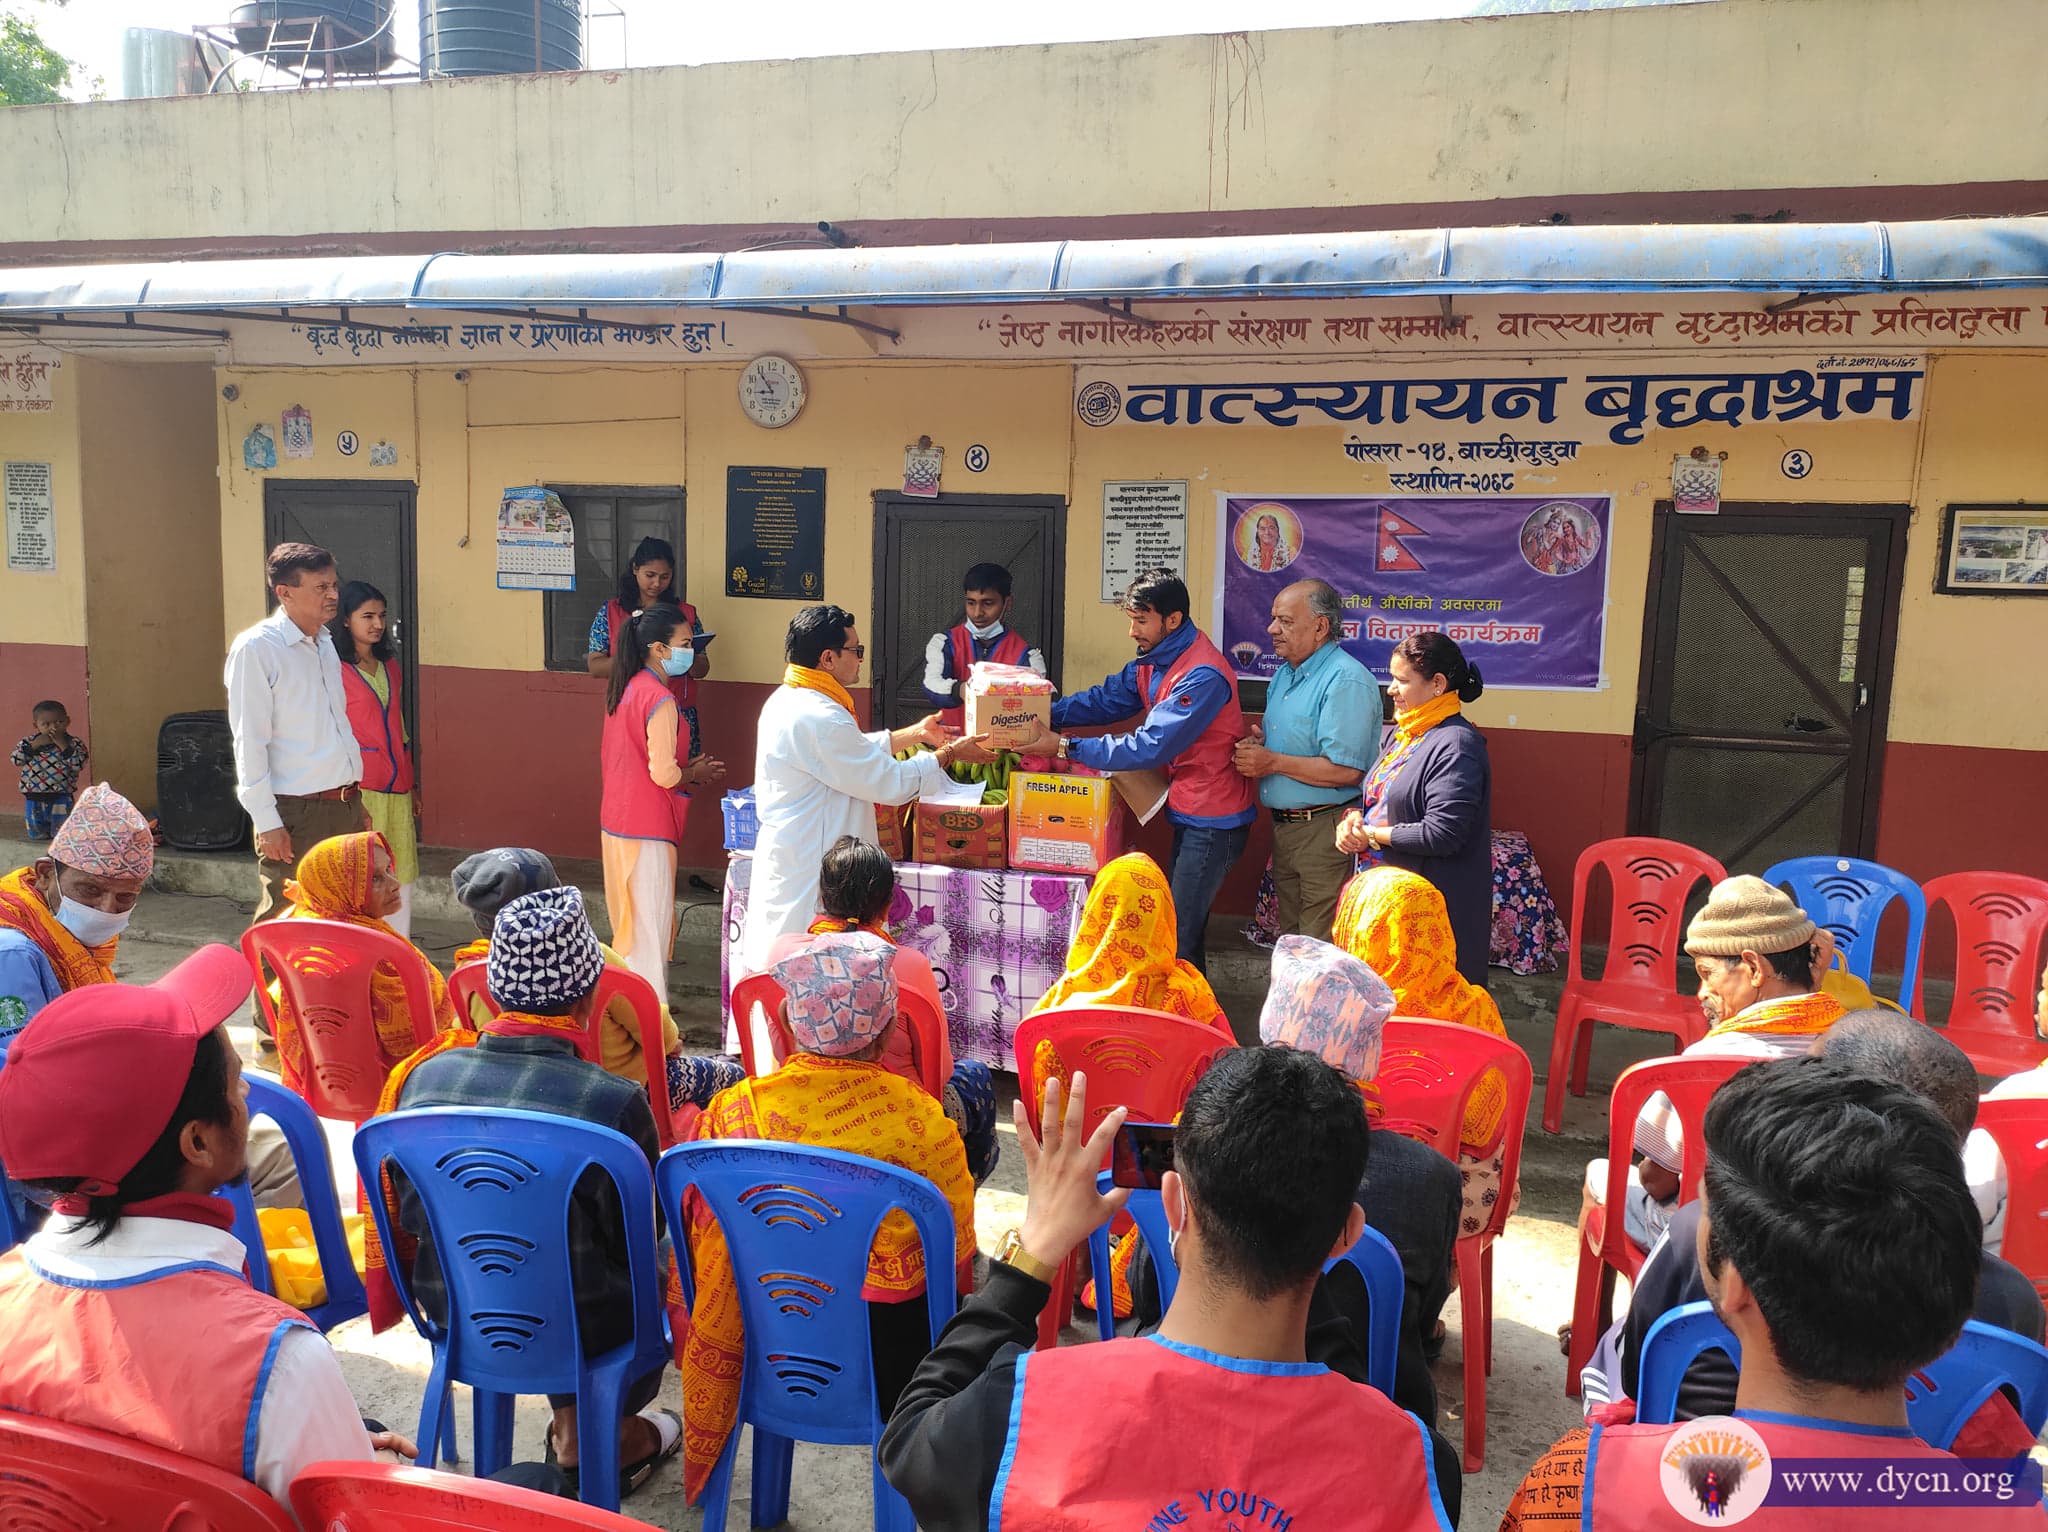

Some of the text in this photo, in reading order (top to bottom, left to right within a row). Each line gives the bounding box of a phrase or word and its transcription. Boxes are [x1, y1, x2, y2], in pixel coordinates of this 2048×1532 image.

[460, 324, 504, 350] ज्ञान
[509, 323, 526, 348] र
[1227, 311, 1312, 349] संरक्षण
[1323, 316, 1375, 344] तथा
[1497, 312, 1664, 341] वात्स्यायन
[1125, 377, 1568, 427] वात्स्यायन
[1343, 434, 1403, 464] पोखरा
[1439, 598, 1503, 612] अवसरमा
[1448, 620, 1543, 643] कार्यक्रम
[1026, 782, 1089, 796] FRESH APPLE
[944, 813, 977, 829] BPS
[1552, 1485, 1580, 1508] कृष्ण
[1196, 1487, 1293, 1532] YOUTH
